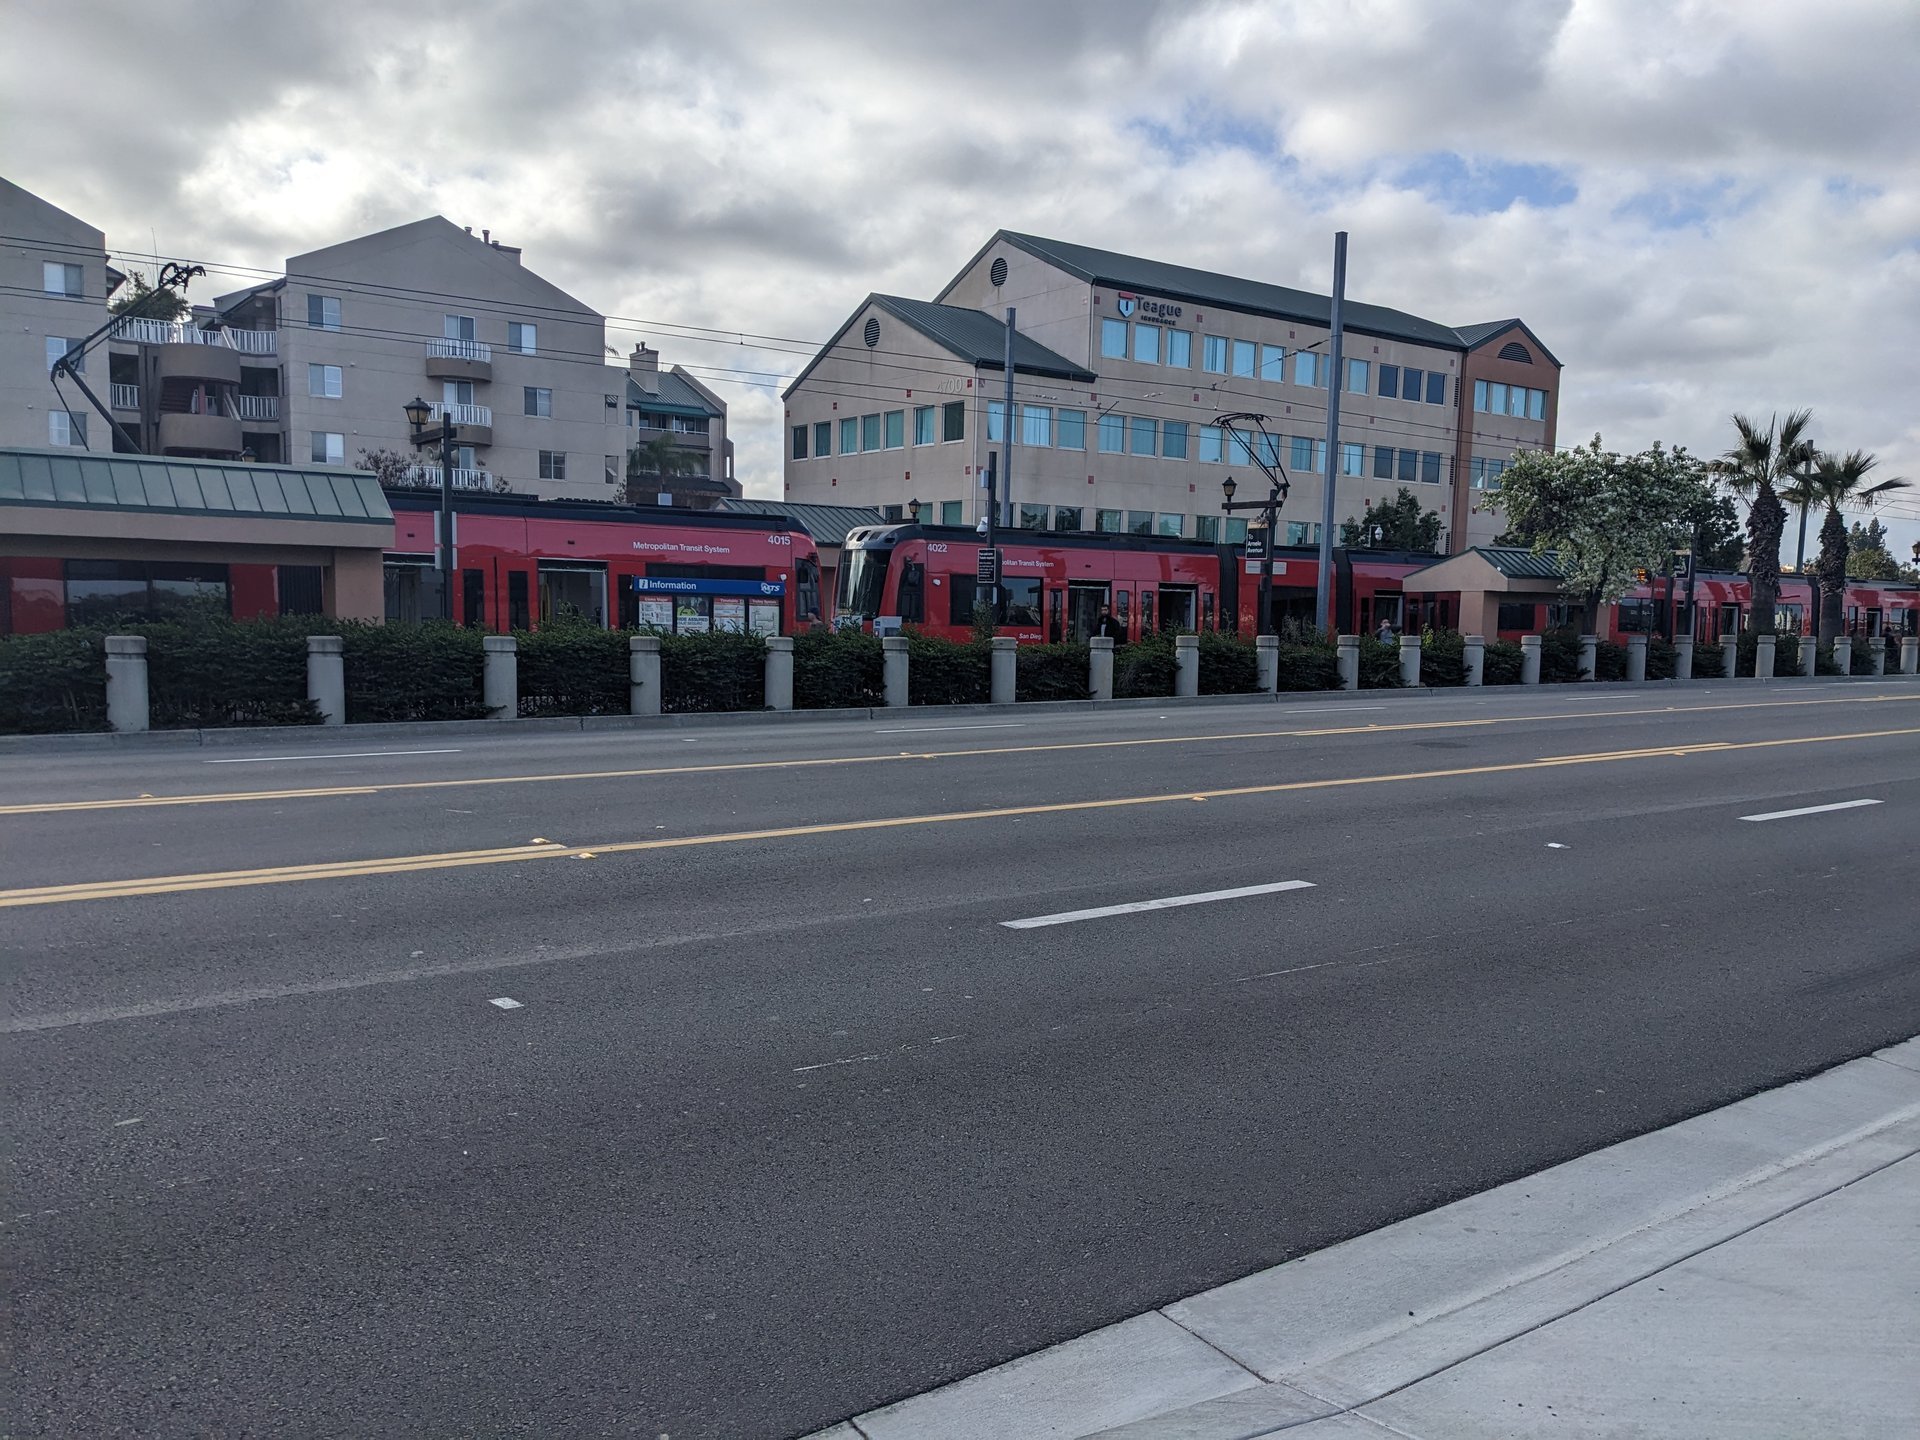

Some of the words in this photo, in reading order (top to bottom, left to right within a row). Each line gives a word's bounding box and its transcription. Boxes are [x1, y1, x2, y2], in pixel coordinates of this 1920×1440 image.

[1135, 295, 1182, 318] Teague
[768, 535, 791, 546] 4015
[633, 541, 679, 552] Metropolitan
[679, 543, 703, 552] Transit
[703, 544, 730, 555] System
[927, 543, 948, 553] 4022
[649, 580, 697, 591] Information
[761, 582, 781, 594] MTS
